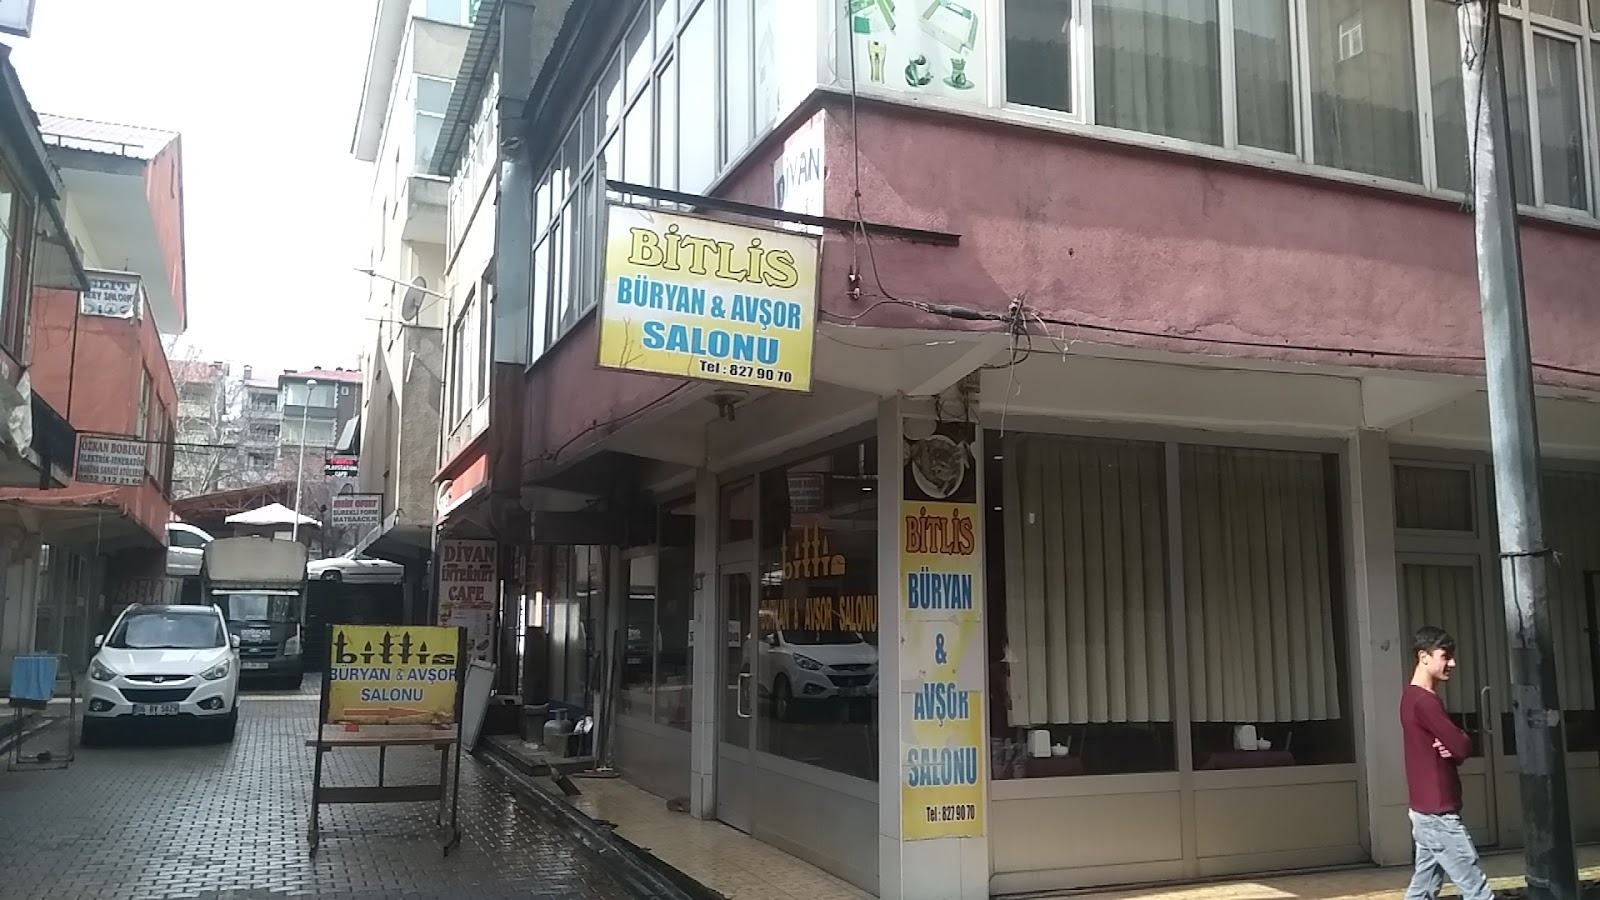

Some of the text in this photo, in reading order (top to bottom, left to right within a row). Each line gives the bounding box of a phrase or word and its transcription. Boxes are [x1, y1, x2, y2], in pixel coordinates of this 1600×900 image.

[627, 223, 799, 289] BİTLİS
[617, 274, 801, 330] BÜRYAN & AVŞOR
[642, 321, 779, 365] SALONU
[699, 360, 720, 374] Tel
[729, 364, 754, 378] 827
[757, 368, 774, 381] 90
[777, 370, 792, 383] 70
[906, 506, 975, 555] BİTLİS
[444, 541, 495, 562] DİVAN
[448, 586, 485, 601] CAFE
[908, 566, 972, 610] BÜRYAN
[840, 595, 878, 632] SALONU
[935, 632, 948, 665] &
[330, 664, 457, 685] BÜRYAN & AVŞOR
[361, 688, 423, 702] SALONU
[908, 747, 977, 787] SALONU
[926, 805, 937, 822] Tel
[942, 805, 955, 821] 827
[956, 804, 966, 821] 90
[966, 804, 976, 820] 70
